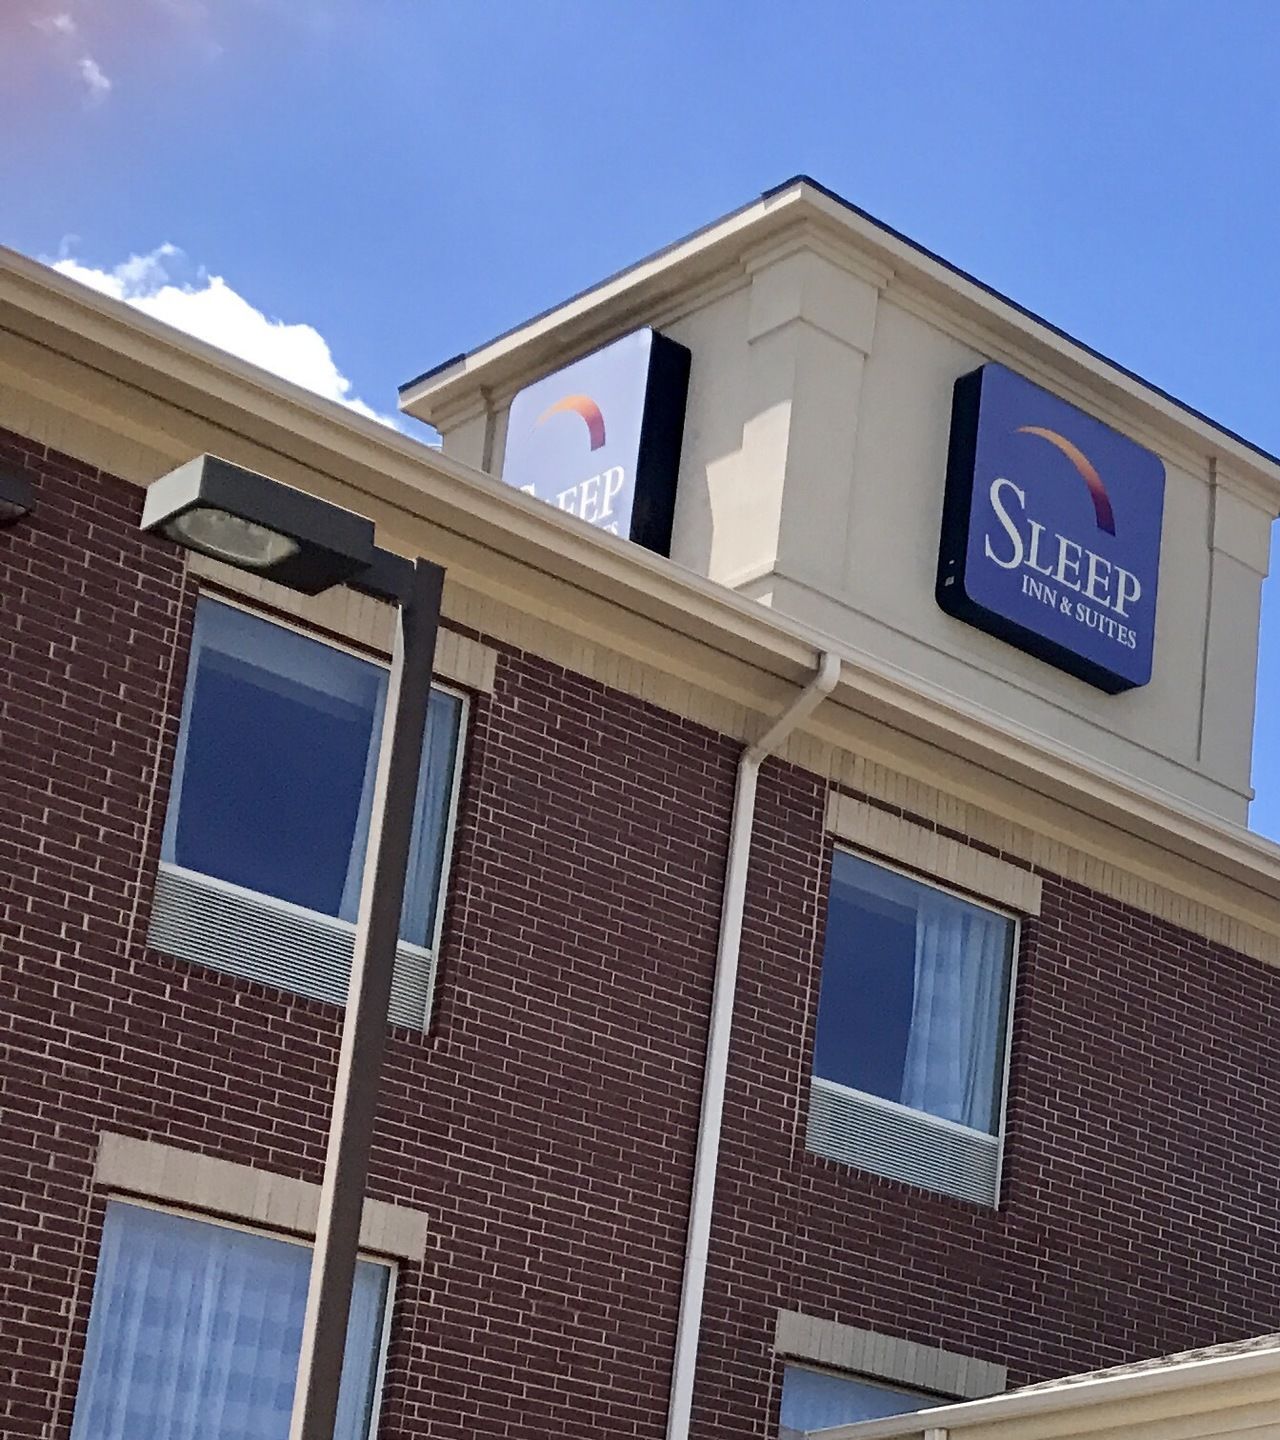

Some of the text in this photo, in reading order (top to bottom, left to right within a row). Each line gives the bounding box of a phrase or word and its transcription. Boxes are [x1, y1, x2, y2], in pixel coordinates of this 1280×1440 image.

[520, 465, 625, 523] EEP
[1021, 574, 1137, 650] INN & SUITES
